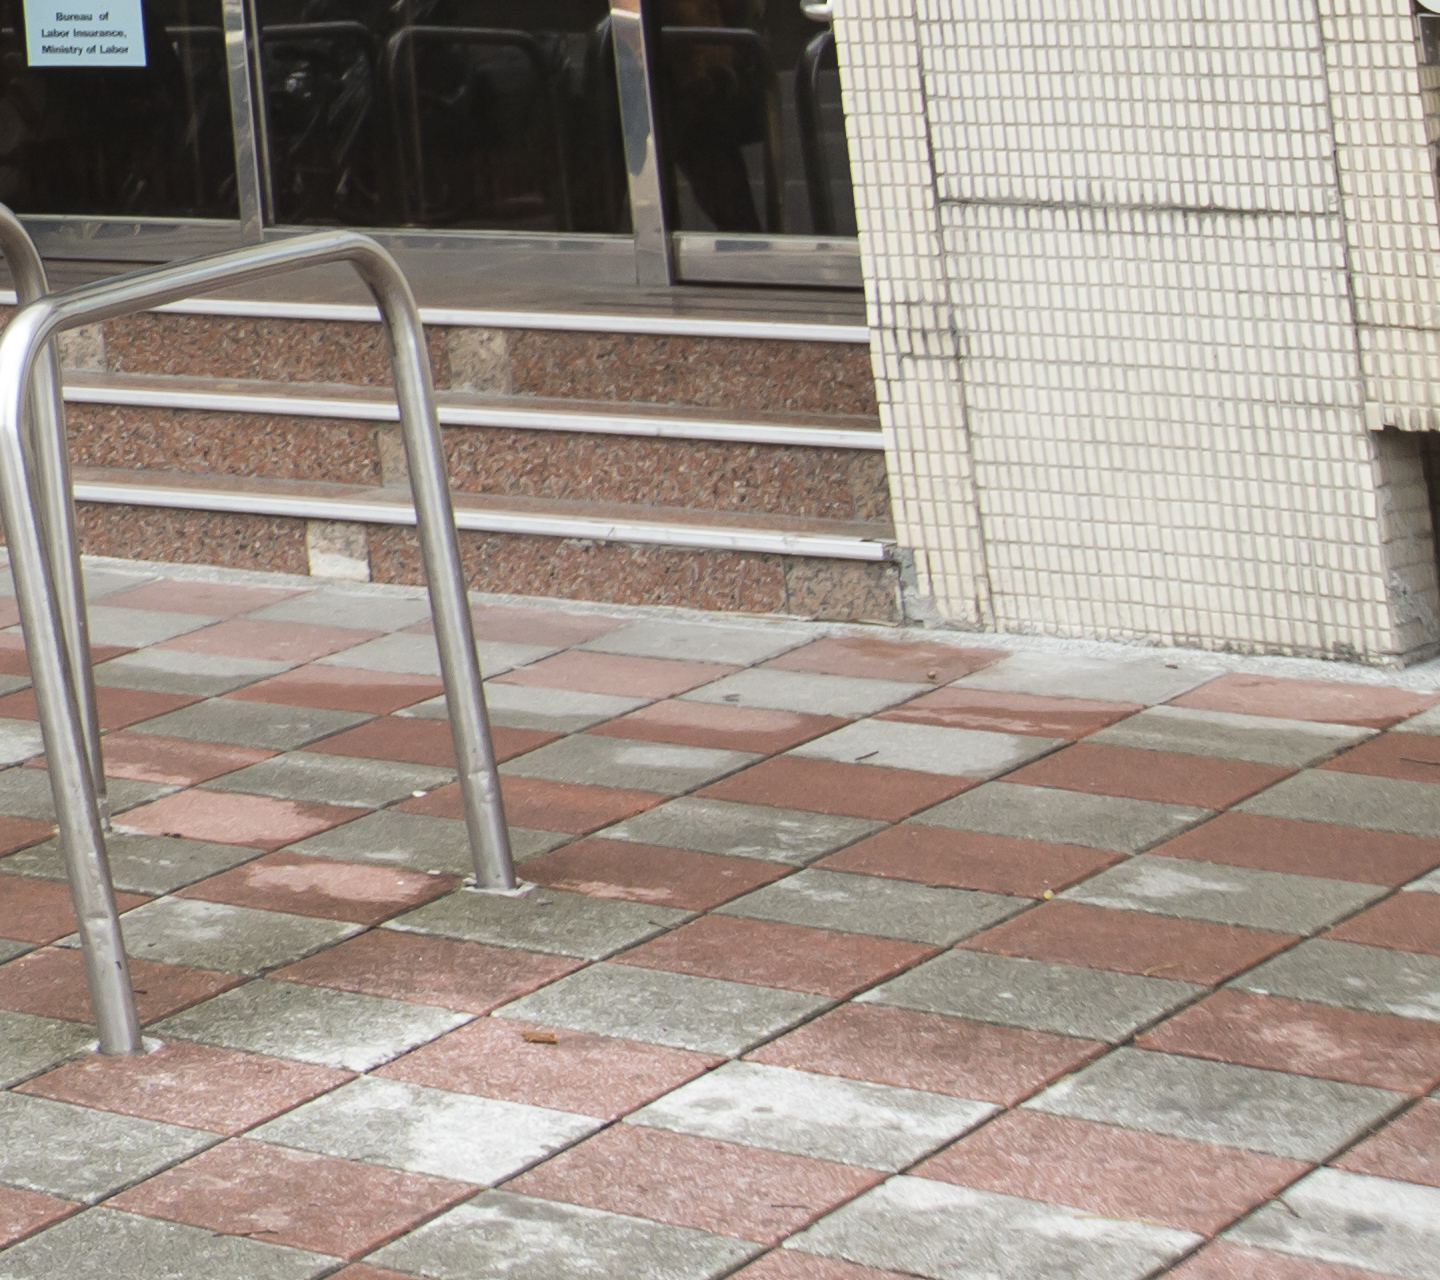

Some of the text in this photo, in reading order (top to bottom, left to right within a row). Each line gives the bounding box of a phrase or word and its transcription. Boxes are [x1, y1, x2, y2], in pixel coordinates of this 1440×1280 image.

[55, 11, 109, 21] Bureau of
[41, 28, 127, 39] Labor Insurance,
[41, 45, 129, 56] Ministry of Labor
